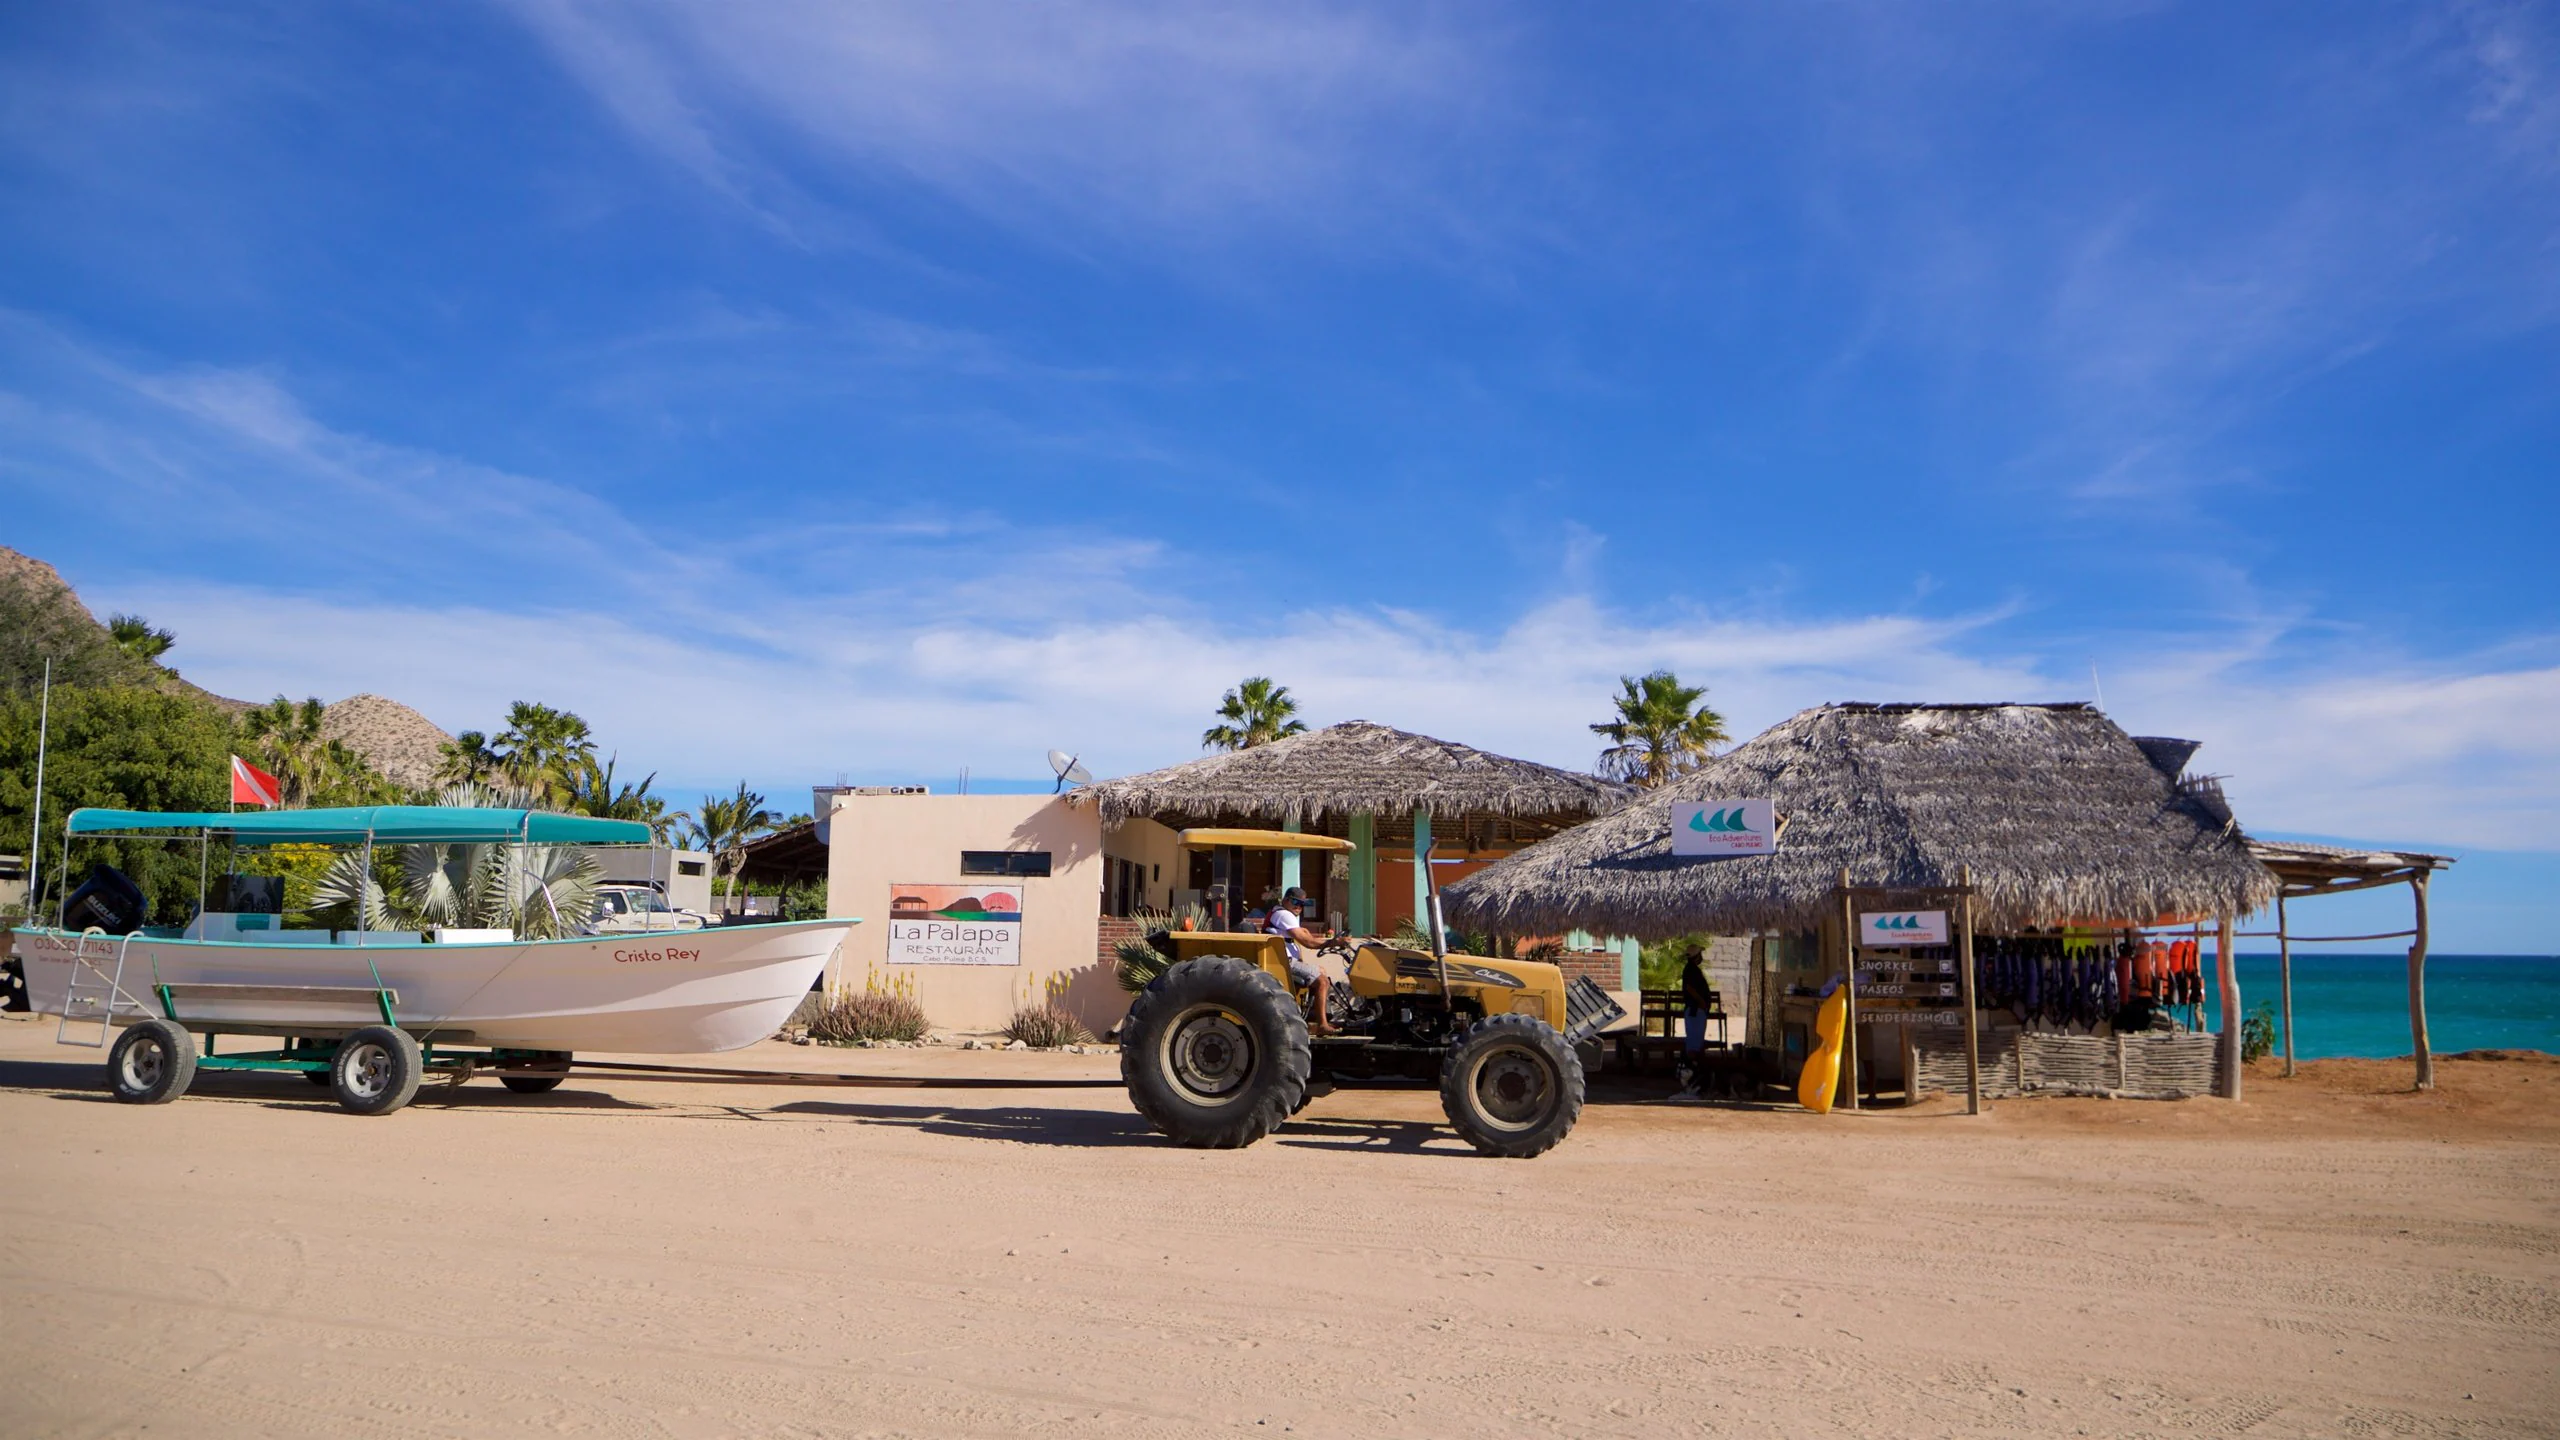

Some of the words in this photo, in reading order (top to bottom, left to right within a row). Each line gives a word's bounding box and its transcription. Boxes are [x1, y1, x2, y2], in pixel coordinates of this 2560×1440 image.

[1709, 834, 1721, 842] Eco
[1723, 833, 1762, 842] Adventures
[87, 895, 121, 925] SUZUKI
[894, 924, 920, 940] La
[928, 924, 1009, 946] Palapa
[614, 949, 662, 963] Cristo
[666, 947, 700, 962] Rey
[906, 945, 1003, 956] RESTAURANT
[1860, 960, 1915, 971] SNORKEL
[1860, 985, 1904, 994] PASEOS
[1862, 1013, 1941, 1023] SENDERISMO
